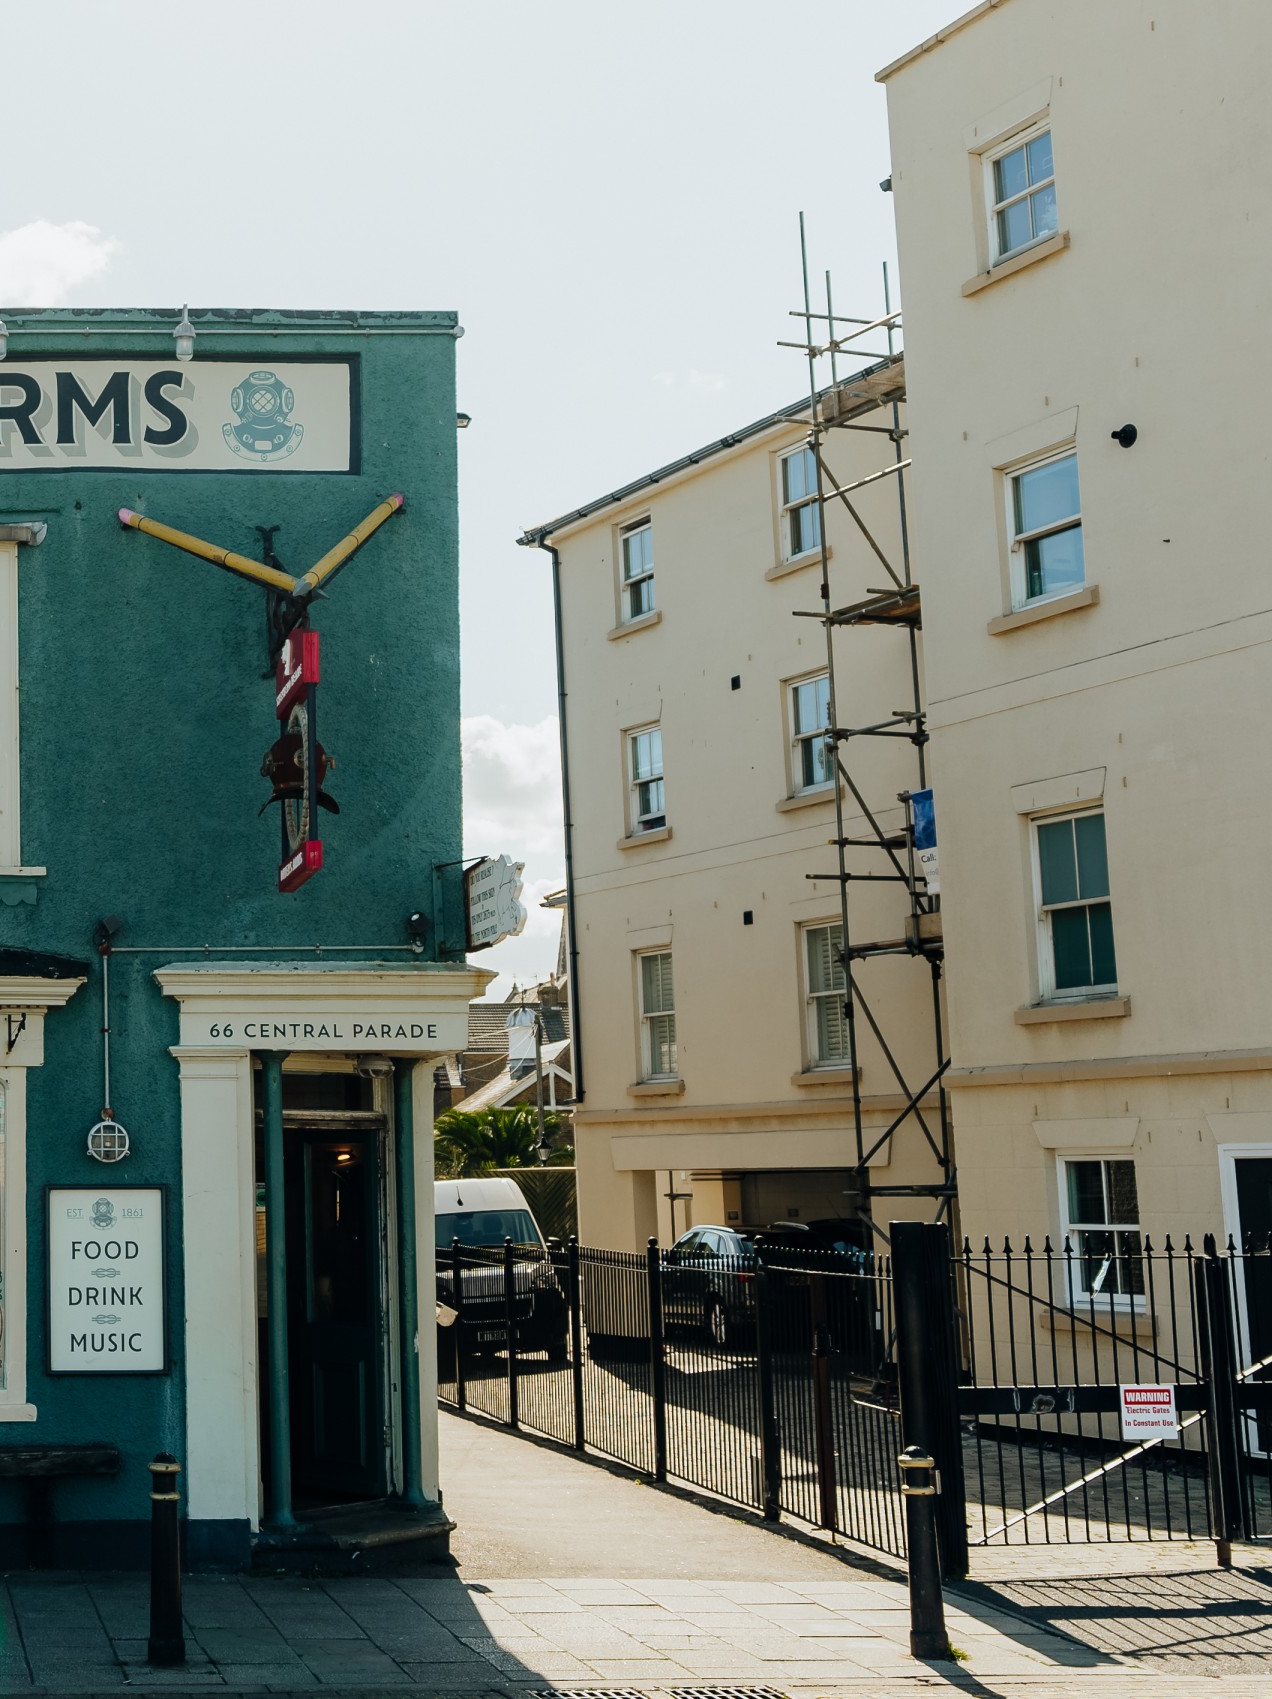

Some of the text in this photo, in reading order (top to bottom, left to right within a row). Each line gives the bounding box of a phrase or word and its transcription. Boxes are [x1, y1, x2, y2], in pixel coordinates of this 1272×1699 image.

[921, 853, 937, 863] Call:
[209, 1023, 438, 1039] 66 CENTRAL PARADE
[121, 1208, 144, 1217] 1861
[71, 1240, 139, 1260] FOOD
[68, 1287, 143, 1306] DRINK
[70, 1333, 142, 1352] MUSIC
[1125, 1392, 1170, 1403] WARNING
[1133, 1419, 1161, 1427] Constant
[1162, 1419, 1174, 1427] Use
